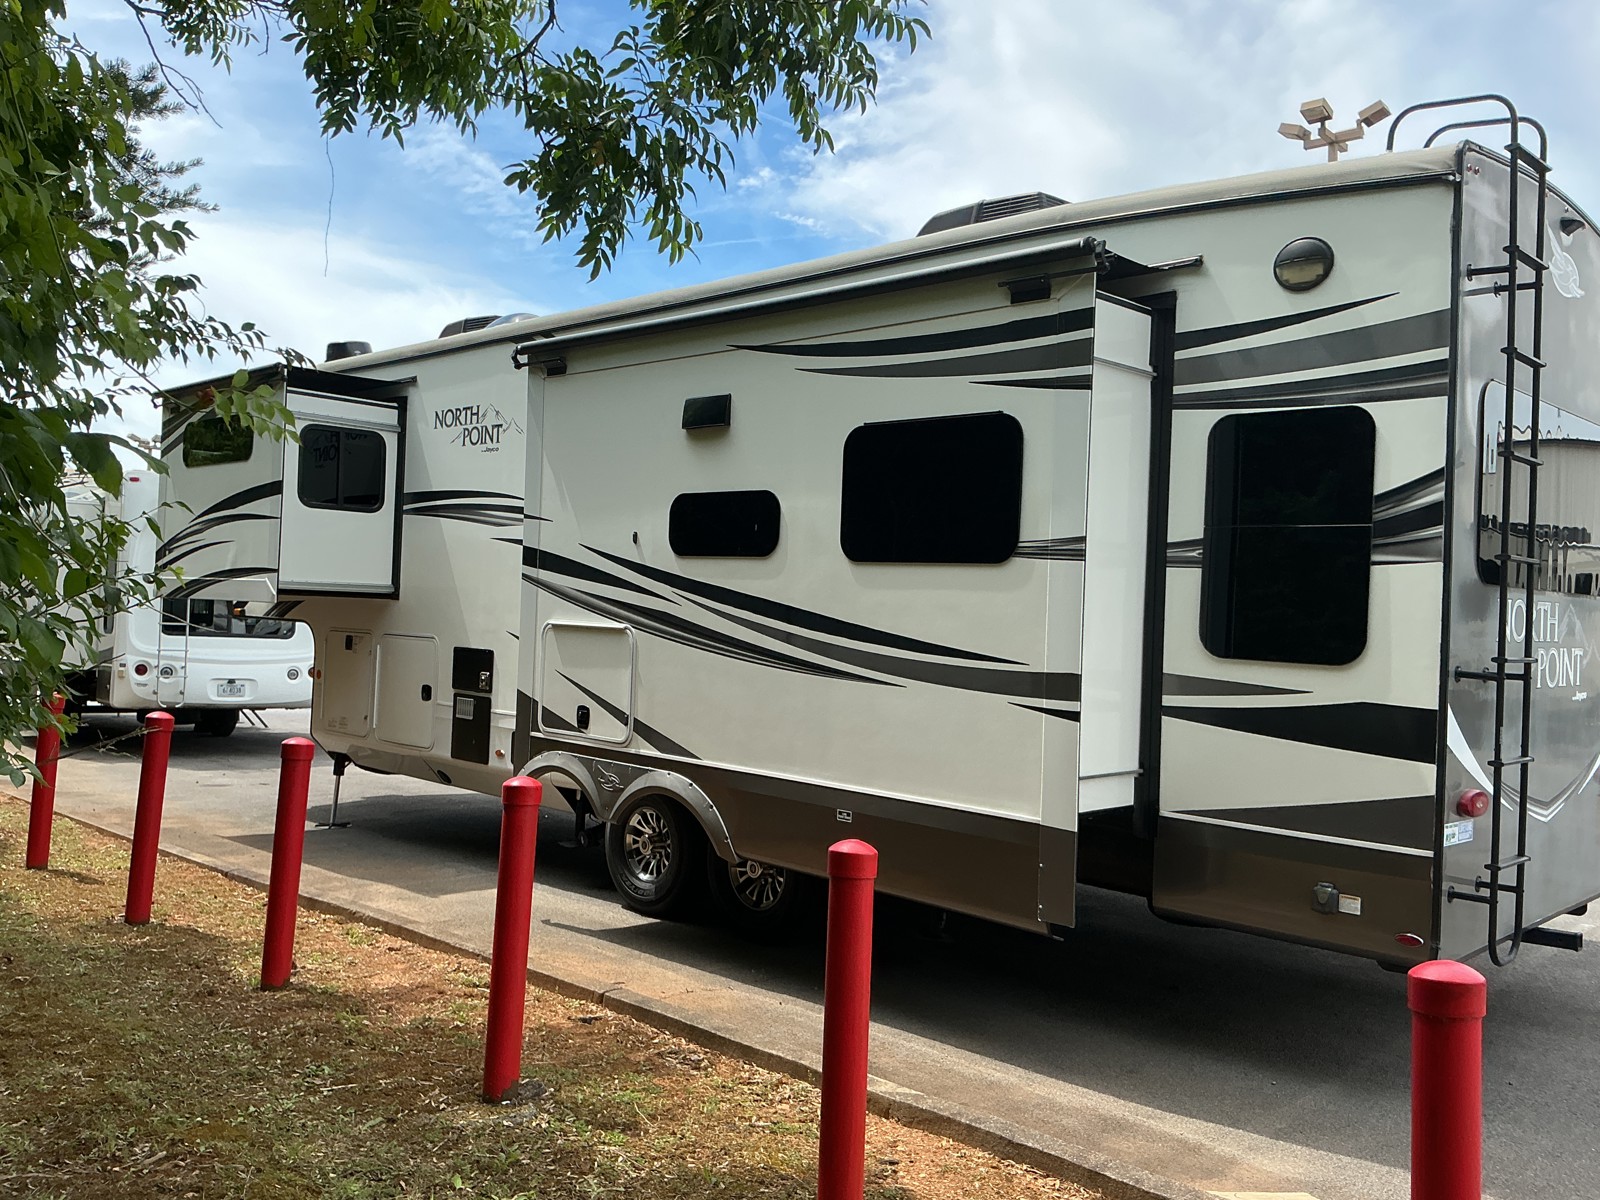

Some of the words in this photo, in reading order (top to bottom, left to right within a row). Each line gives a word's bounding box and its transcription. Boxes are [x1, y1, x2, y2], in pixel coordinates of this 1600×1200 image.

[434, 404, 480, 429] NORTH
[462, 423, 503, 447] POINT
[1536, 647, 1584, 689] POINT
